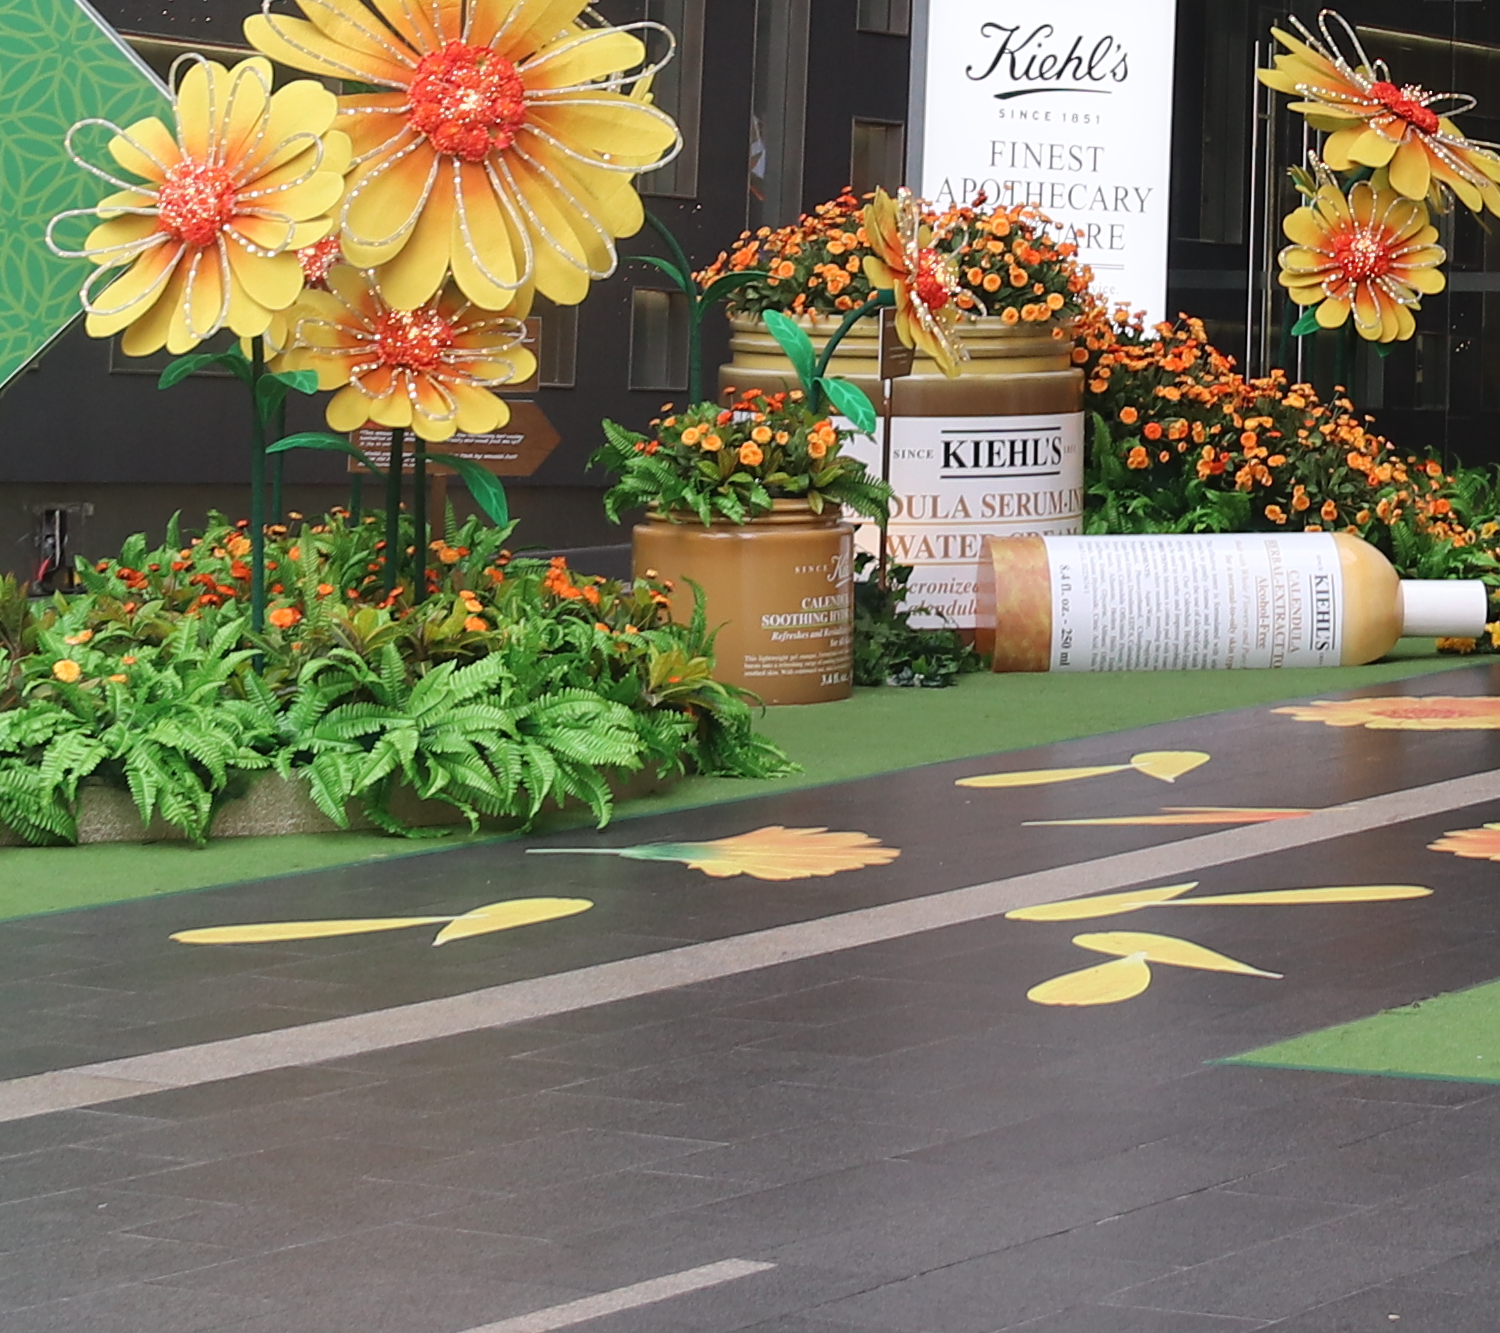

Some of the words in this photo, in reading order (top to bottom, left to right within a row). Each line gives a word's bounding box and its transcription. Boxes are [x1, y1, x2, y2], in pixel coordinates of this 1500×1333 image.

[965, 22, 1129, 82] Kiehl's
[998, 108, 1052, 121] SINCE
[1062, 112, 1102, 125] 1851
[989, 139, 1105, 173] FINEST
[935, 176, 1155, 214] APOTHECARY
[893, 448, 935, 459] SINCE
[940, 436, 1062, 469] KIEHL'S
[908, 577, 978, 595] cronize
[1269, 540, 1287, 651] HERBAL-EXTRACT
[762, 610, 828, 627] SOOTHING
[908, 600, 977, 617] alendul
[1258, 576, 1270, 649] Alcohol-Free
[1290, 570, 1302, 653] CALENDULA
[1315, 574, 1330, 651] KIEHL'S
[1062, 628, 1072, 648] 250
[1059, 652, 1071, 666] ml
